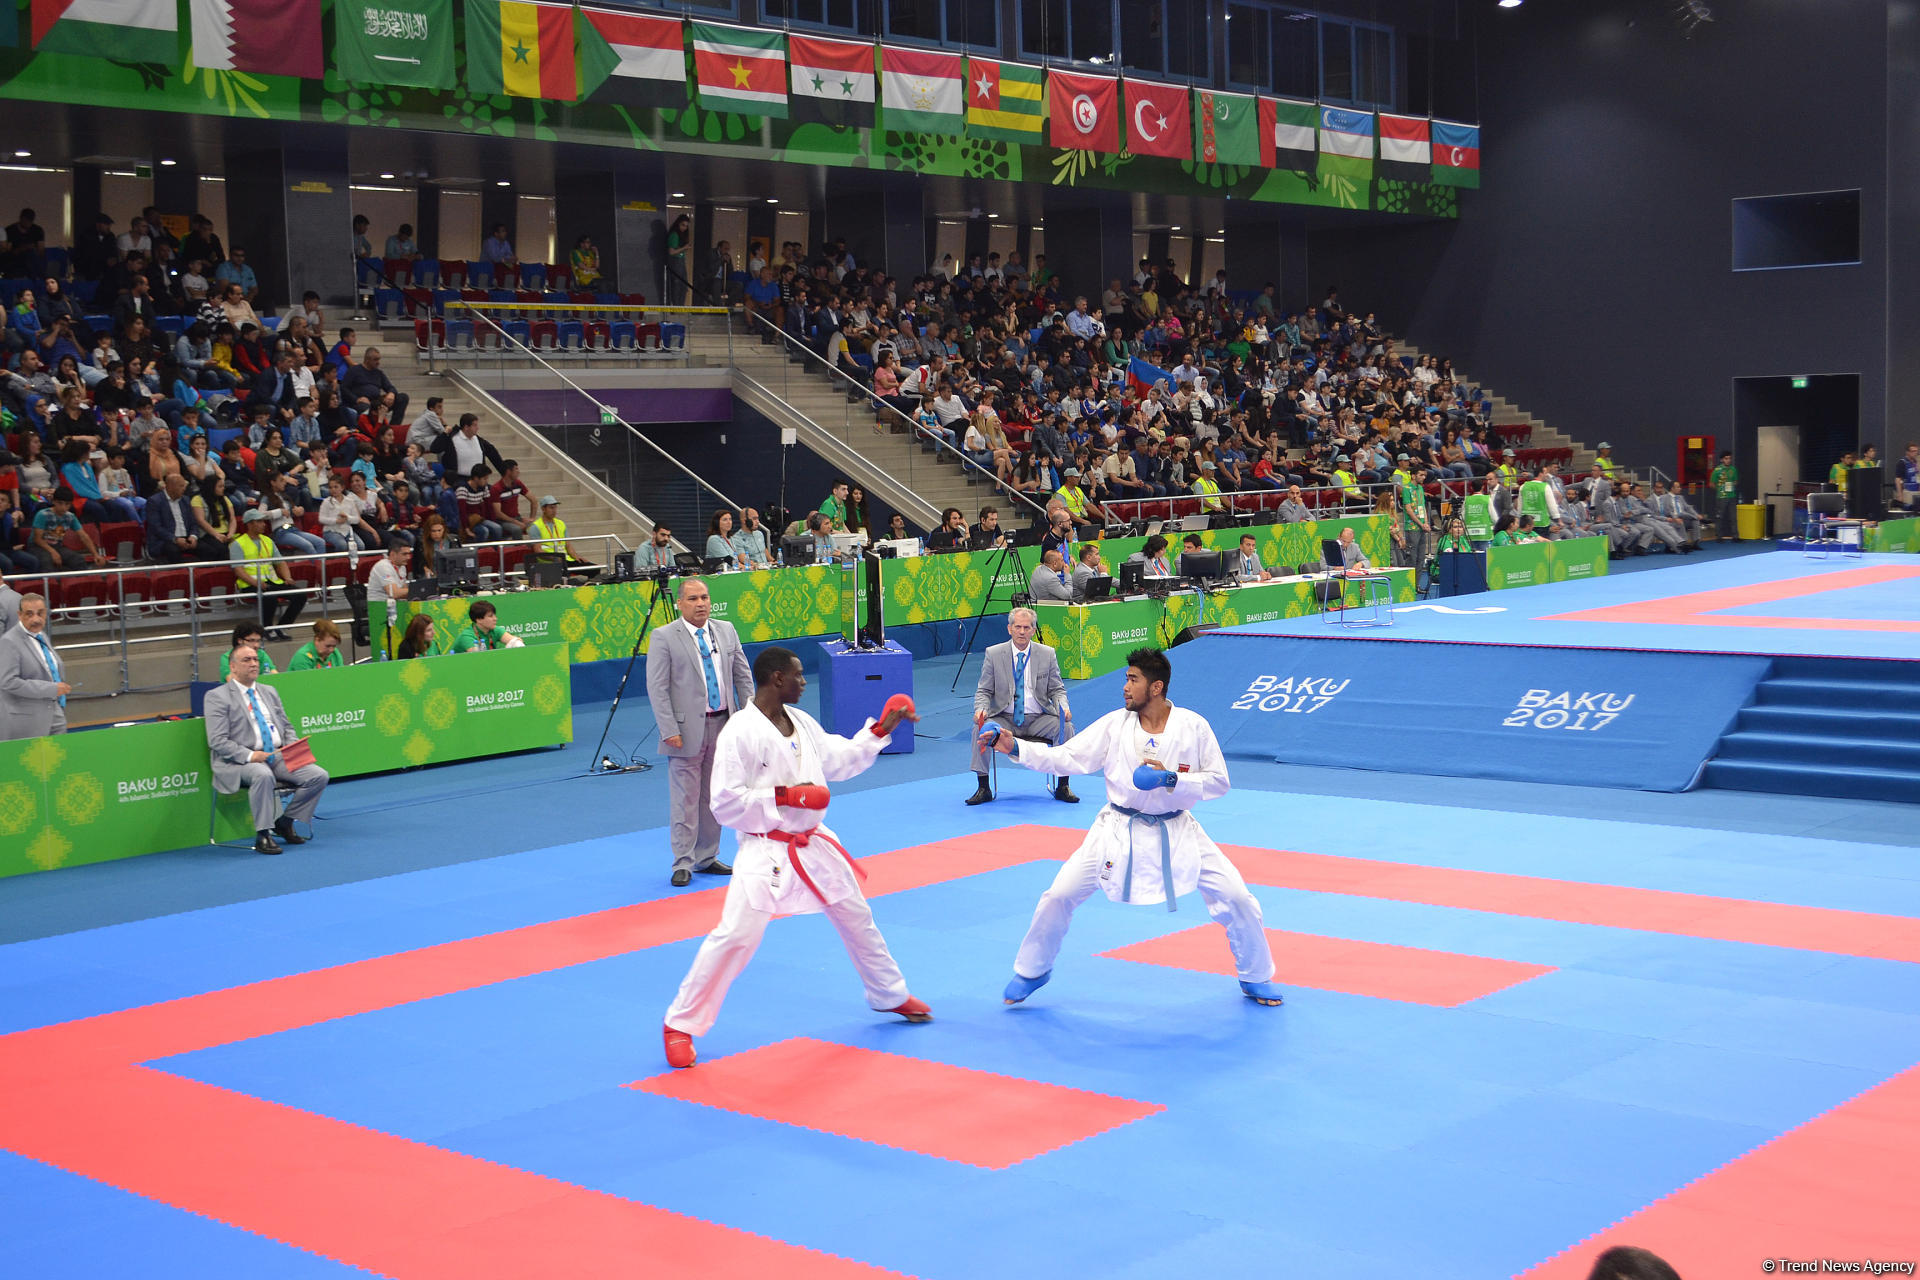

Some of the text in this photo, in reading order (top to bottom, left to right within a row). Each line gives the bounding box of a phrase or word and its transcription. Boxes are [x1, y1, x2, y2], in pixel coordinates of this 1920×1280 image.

[500, 621, 548, 633] AKU 2017
[1112, 628, 1148, 640] BAKU 2017
[1246, 675, 1351, 695] BAKU
[466, 689, 524, 706] BAKU 2017
[1230, 693, 1334, 713] 2017
[1516, 689, 1636, 712] BAKU
[301, 709, 366, 727] BAKU 2017
[1502, 708, 1620, 730] 2017
[118, 772, 198, 794] BAKU 2017
